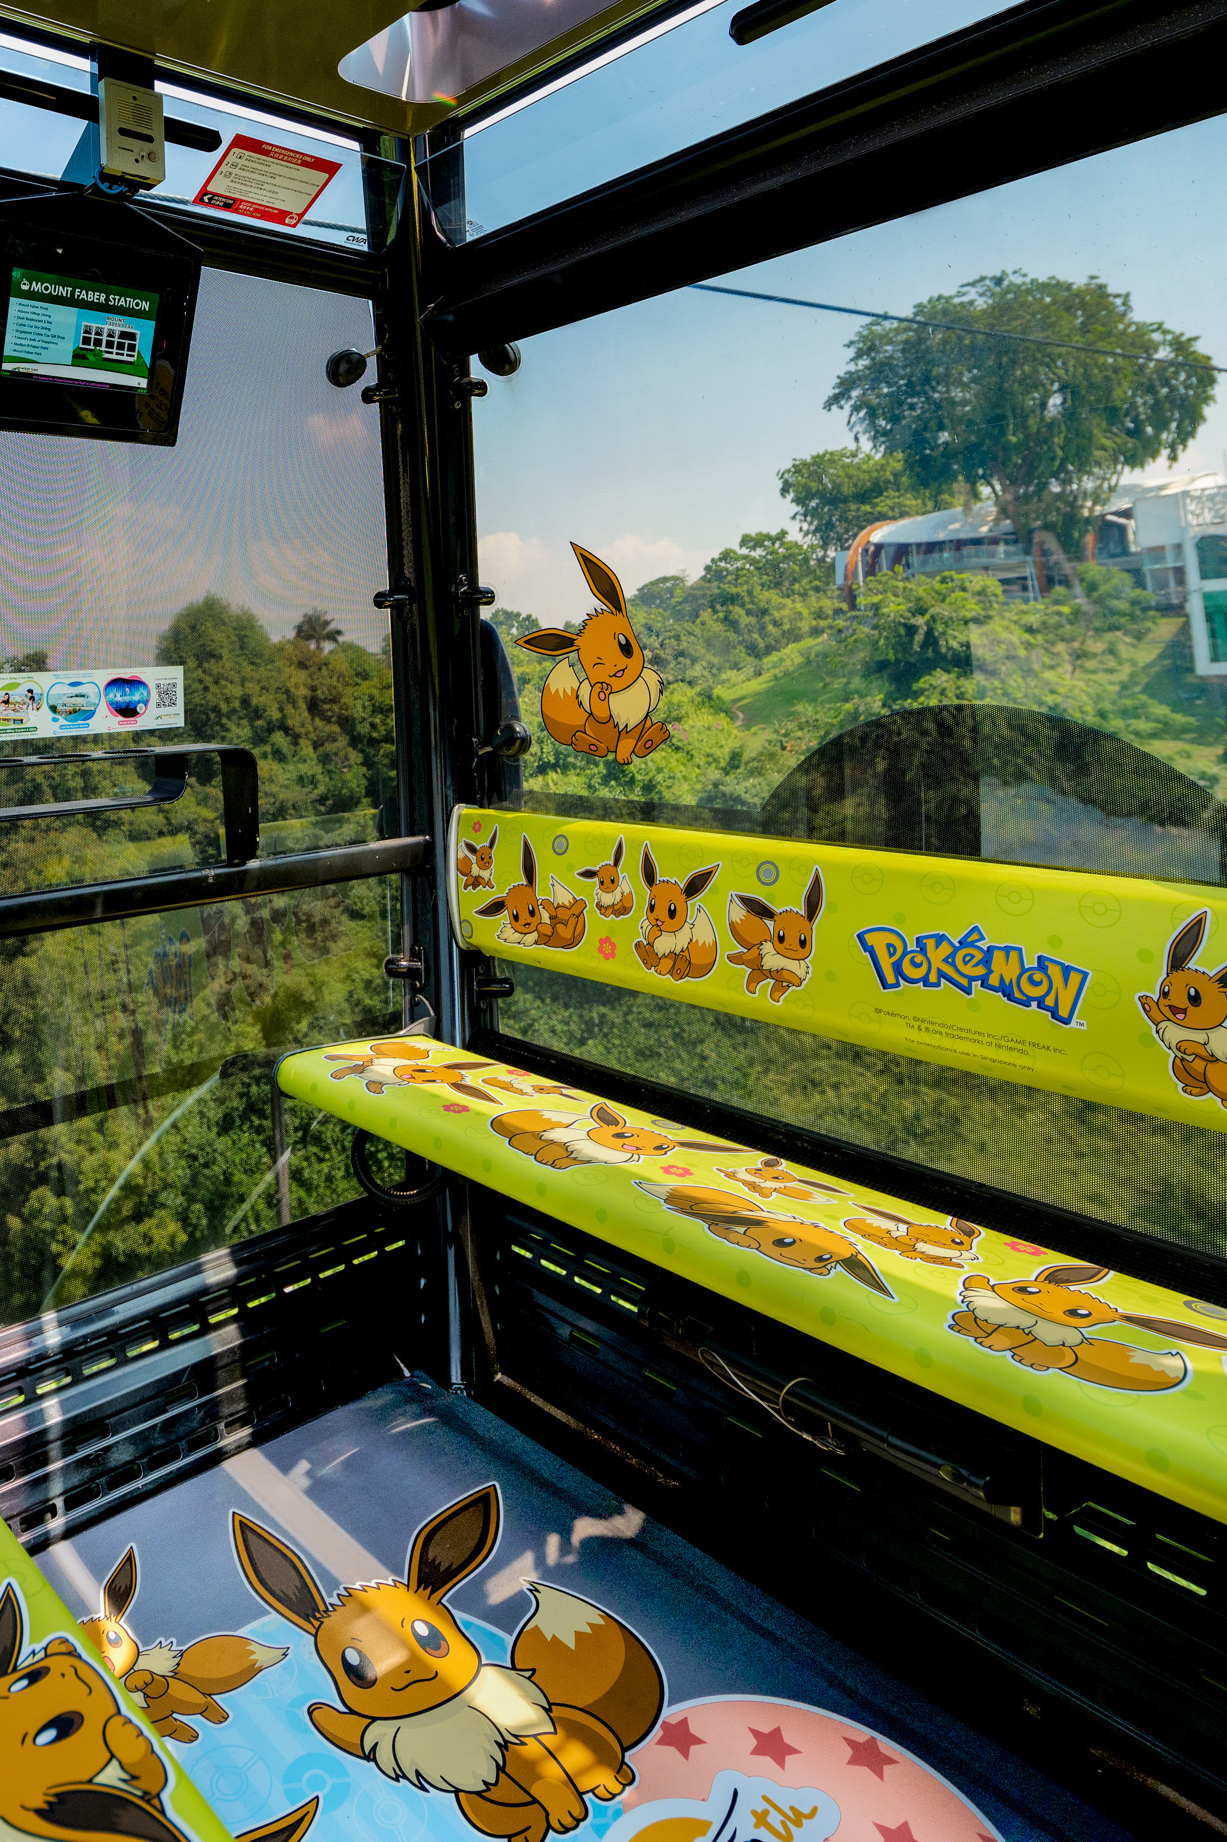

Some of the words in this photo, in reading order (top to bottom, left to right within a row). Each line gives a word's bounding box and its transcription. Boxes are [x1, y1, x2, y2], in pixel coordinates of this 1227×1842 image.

[346, 235, 368, 244] CWA
[30, 281, 72, 298] MOUNT
[74, 289, 106, 303] FABER
[108, 295, 150, 311] STATION
[905, 1022, 914, 1030] TM
[945, 1031, 984, 1045] trademarks
[995, 1042, 1031, 1056] Nintendo.
[1028, 1041, 1051, 1052] FREAK
[980, 1054, 1017, 1068] Singapore
